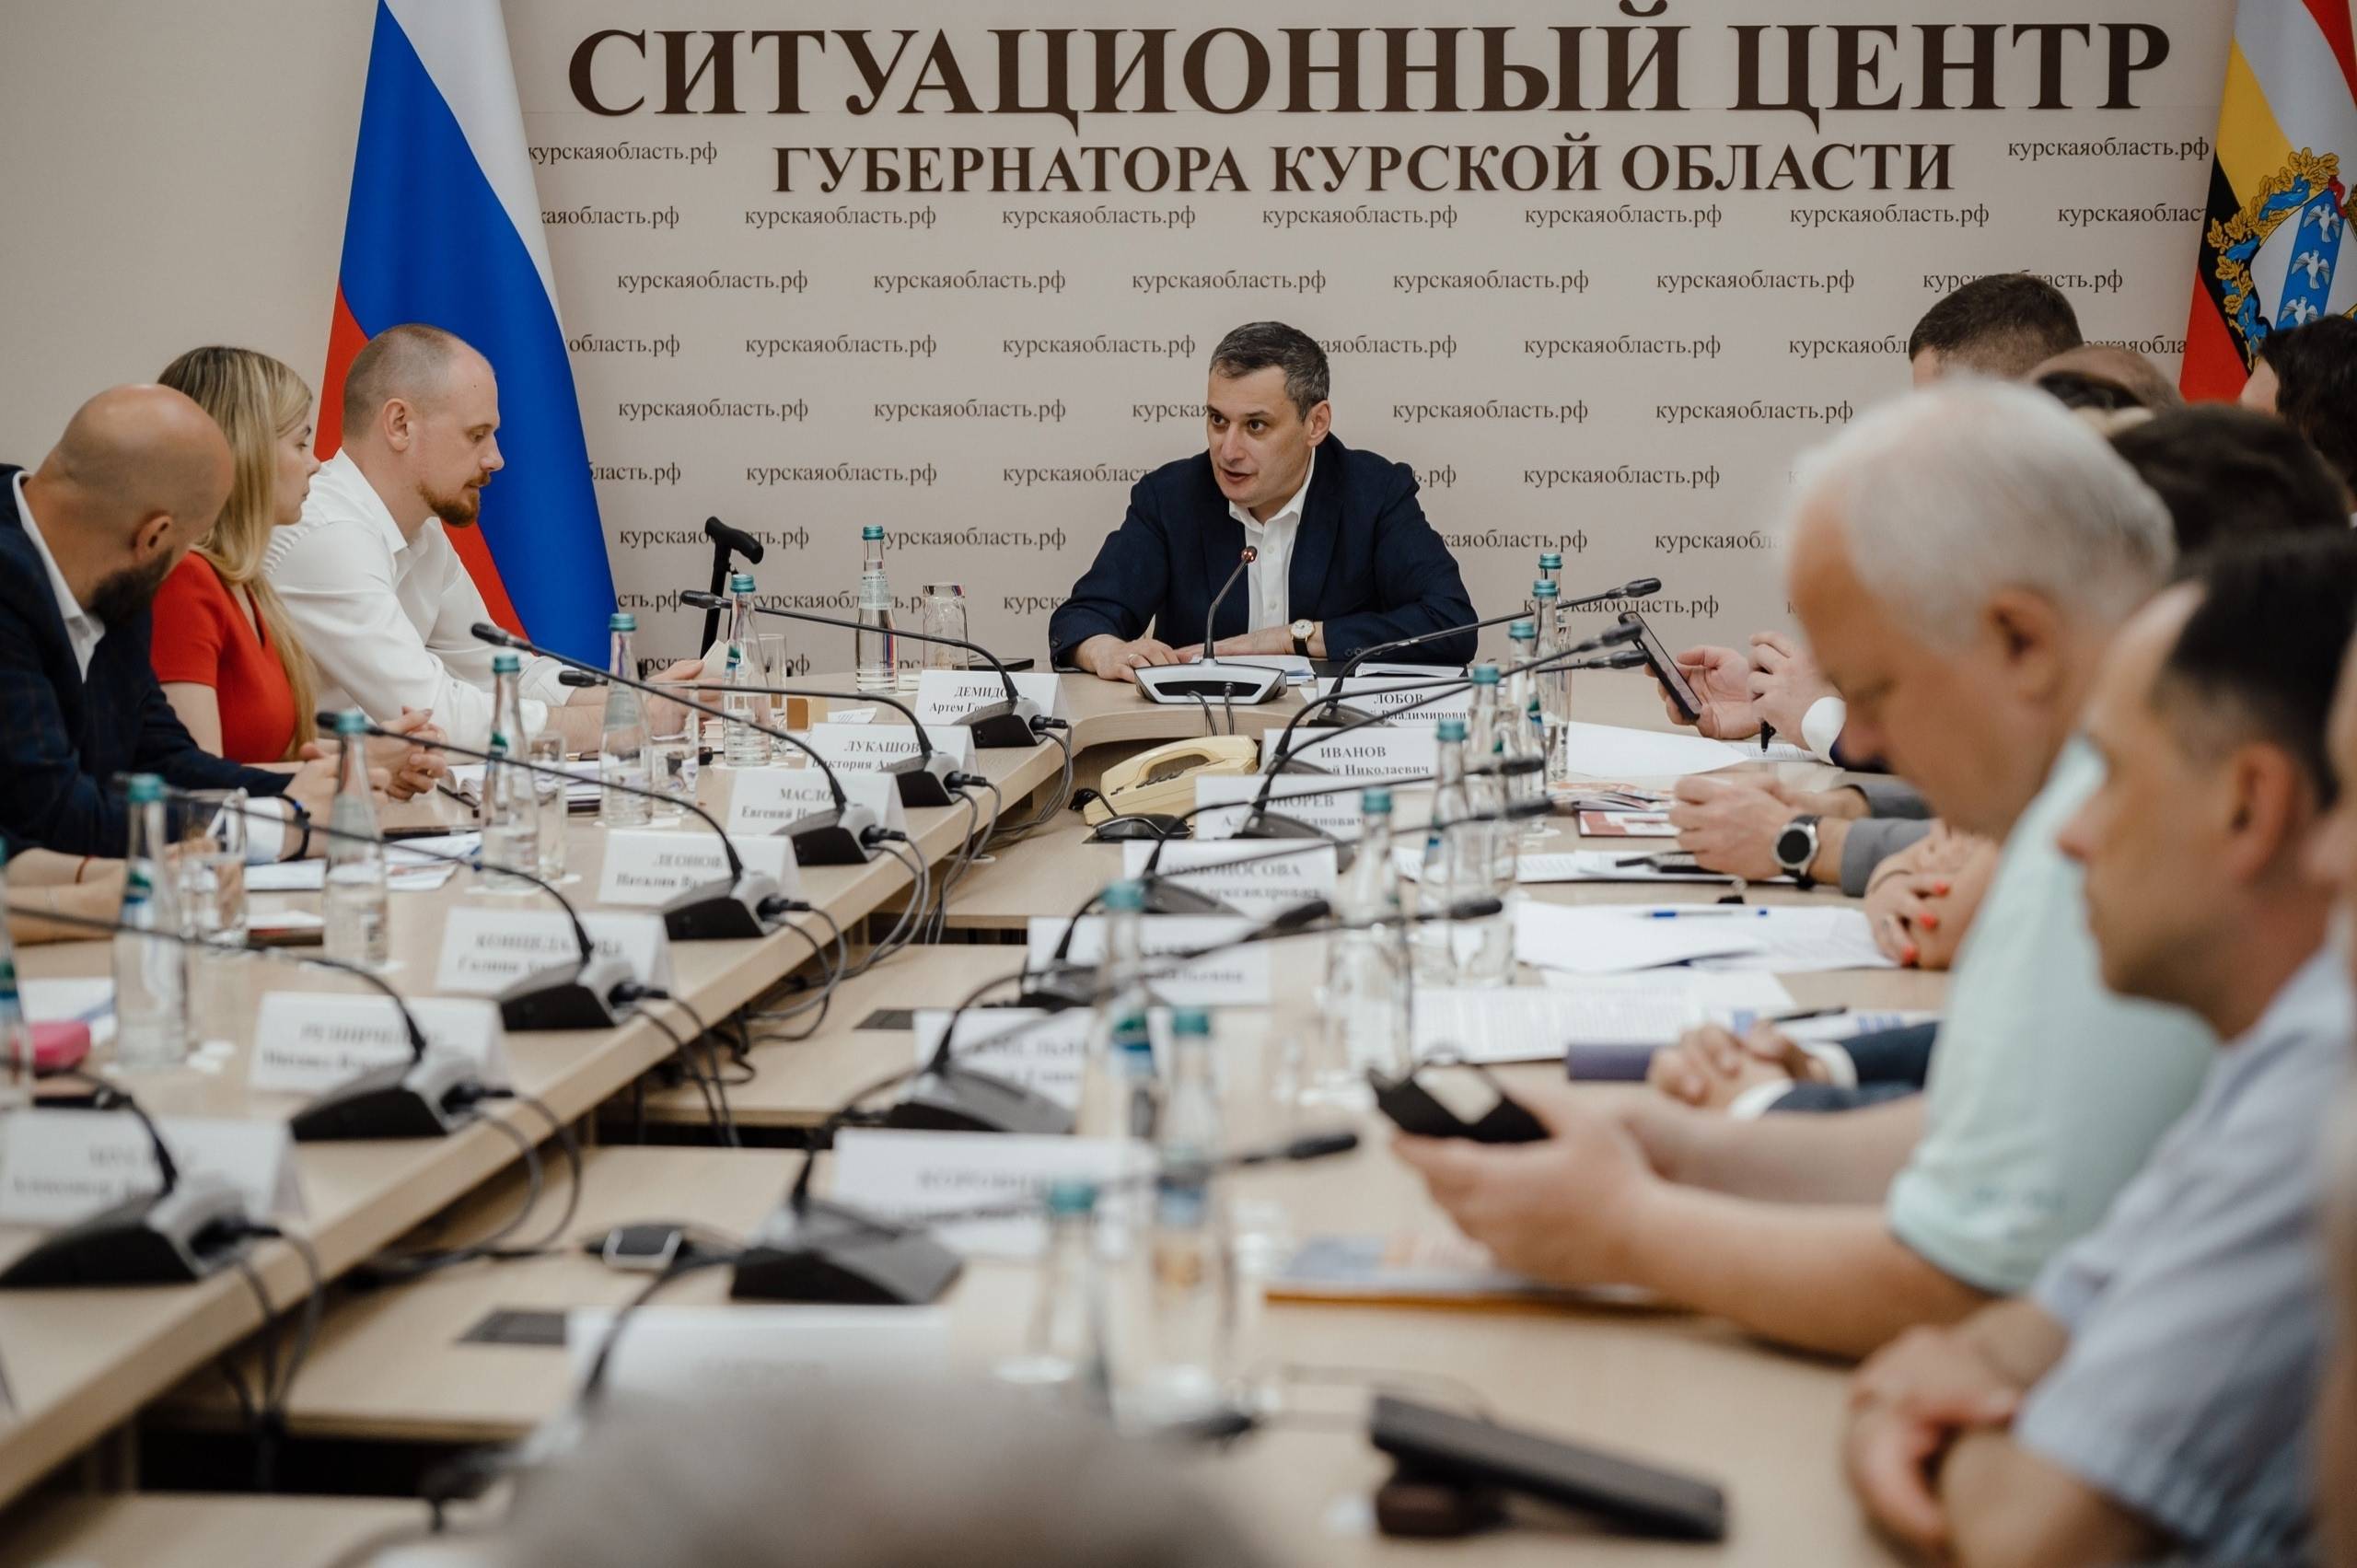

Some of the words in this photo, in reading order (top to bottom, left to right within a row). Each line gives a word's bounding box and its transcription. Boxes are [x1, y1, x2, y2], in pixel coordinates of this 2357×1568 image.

[568, 0, 1691, 137] СИТУАЦИОННЫЙ
[1726, 23, 2171, 134] ЦЕНТР
[528, 141, 718, 166] курскаяобласть.рф
[2008, 136, 2210, 162] курскаяобласть.рф
[772, 145, 1251, 193] ГУБЕРНАТОРА
[1270, 132, 1603, 192] КУРСКОЙ
[1621, 143, 1956, 192] ОБЛАСТИ
[541, 205, 679, 229] аяобласть.рф
[745, 205, 936, 229] курскаяобласть.рф
[1002, 205, 1196, 229] курскаяобласть.рф
[1262, 204, 1458, 229] курскаяобласть.рф
[1525, 203, 1723, 228] курскаяобласть.рф
[1790, 203, 1990, 228] курскаяобласть.рф
[2058, 203, 2208, 227] курскаяоблас
[617, 270, 808, 294] курскаяобласть.рф
[874, 270, 1066, 294] курскаяобласть.рф
[1132, 270, 1327, 294] курскаяобласть.рф
[1393, 270, 1589, 294] курскаяобласть.рф
[1657, 269, 1855, 294] курскаяобласть.рф
[569, 334, 680, 358] область.рф
[745, 334, 937, 358] курскаяобласть.рф
[1003, 334, 1196, 358] курскаяобласть.рф
[1318, 334, 1457, 359] аяобласть.рф
[1525, 334, 1722, 359] курскаяобласть.рф
[1789, 334, 1909, 359] курскаяобл
[618, 399, 809, 423] курскаяобласть.рф
[875, 399, 1066, 423] курскаяобласть.рф
[1392, 400, 1588, 424] курскаяобласть.рф
[1655, 400, 1853, 424] курскаяобласть.рф
[746, 462, 937, 487] курскаяобласть.рф
[1524, 465, 1721, 489] курскаяобласть.рф
[620, 526, 810, 550] курскаяоть.рф
[884, 527, 1066, 551] урскаяобласть.рф
[1443, 529, 1588, 553] каяобласть.рф
[954, 686, 1007, 699] ДЕМИДО
[1373, 693, 1424, 704] ЛОБОВ
[1381, 710, 1468, 722] Владимирови
[844, 740, 921, 753] ЛУКАШОВ
[1320, 747, 1387, 759] ИВАНОВ
[1344, 764, 1429, 776] Николаевич
[780, 788, 833, 801] МАСЛО
